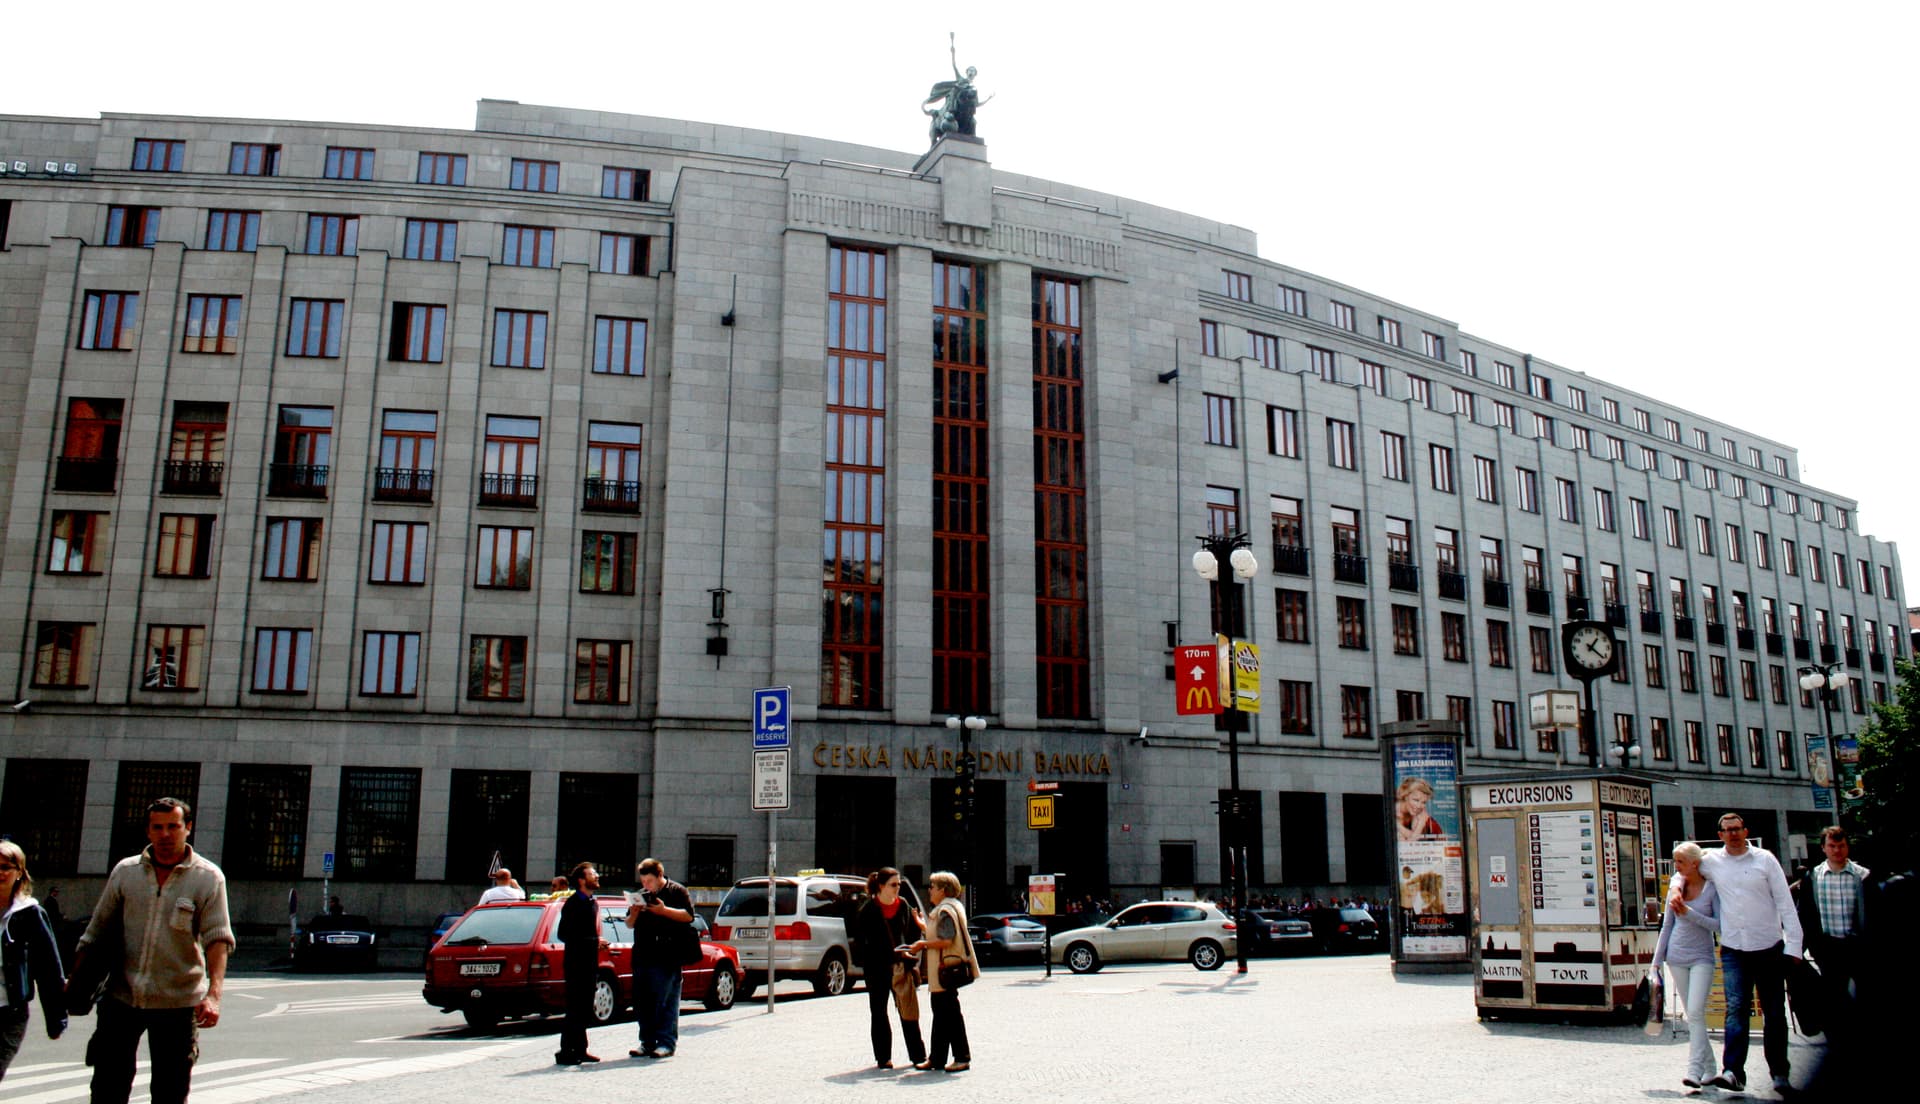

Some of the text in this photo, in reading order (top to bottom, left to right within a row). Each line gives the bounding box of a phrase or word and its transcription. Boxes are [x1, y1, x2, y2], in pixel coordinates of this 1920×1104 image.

[1184, 649, 1210, 658] 170m
[761, 696, 781, 729] P
[813, 741, 890, 769] ČESKÁ
[1035, 751, 1111, 775] BANKA
[1489, 785, 1573, 805] EXCURSIONS
[1609, 784, 1620, 801] CITY
[1622, 787, 1642, 805] TOURS
[1033, 806, 1049, 818] TAXI
[1483, 966, 1522, 977] MARTIN
[1551, 969, 1588, 980] TOUR
